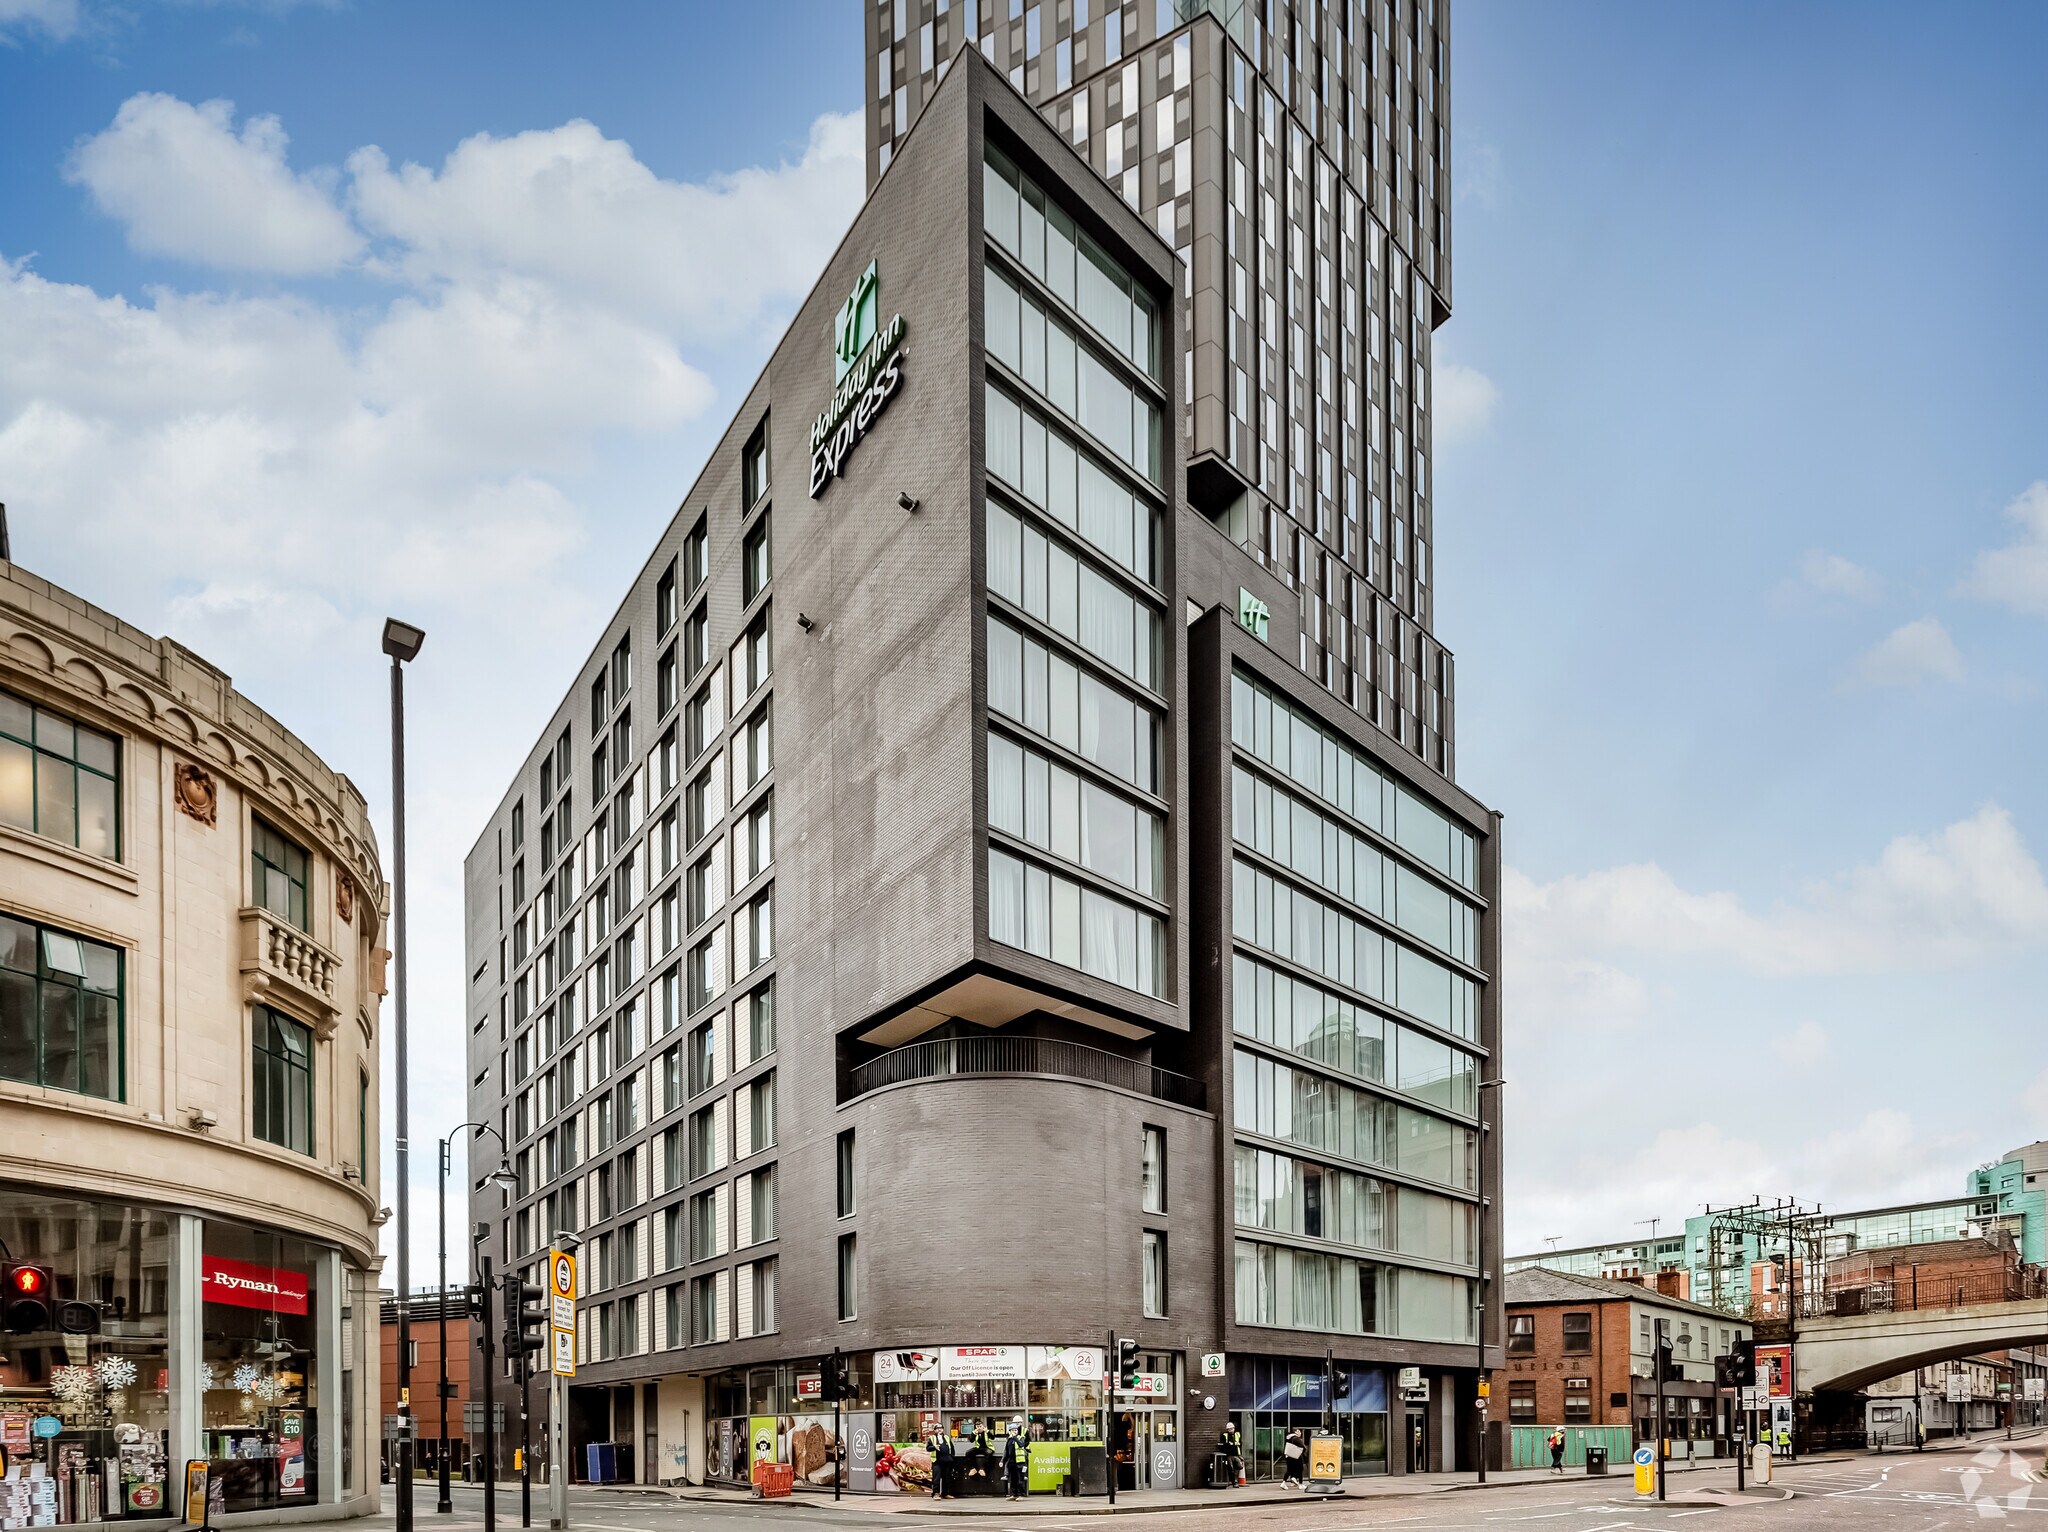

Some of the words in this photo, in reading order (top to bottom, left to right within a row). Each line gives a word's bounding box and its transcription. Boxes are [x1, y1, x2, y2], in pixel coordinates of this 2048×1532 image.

[809, 354, 870, 454] Holiday
[871, 312, 900, 368] Inn
[809, 350, 899, 499] Express
[213, 1271, 280, 1294] Ryman
[880, 1358, 891, 1368] 24
[1077, 1355, 1091, 1366] 24
[806, 1381, 821, 1393] SP
[284, 1425, 300, 1434] £10
[855, 1434, 867, 1447] 24
[1033, 1456, 1070, 1464] Available
[1157, 1455, 1172, 1468] 24
[1037, 1466, 1046, 1474] in
[1047, 1466, 1069, 1474] store
